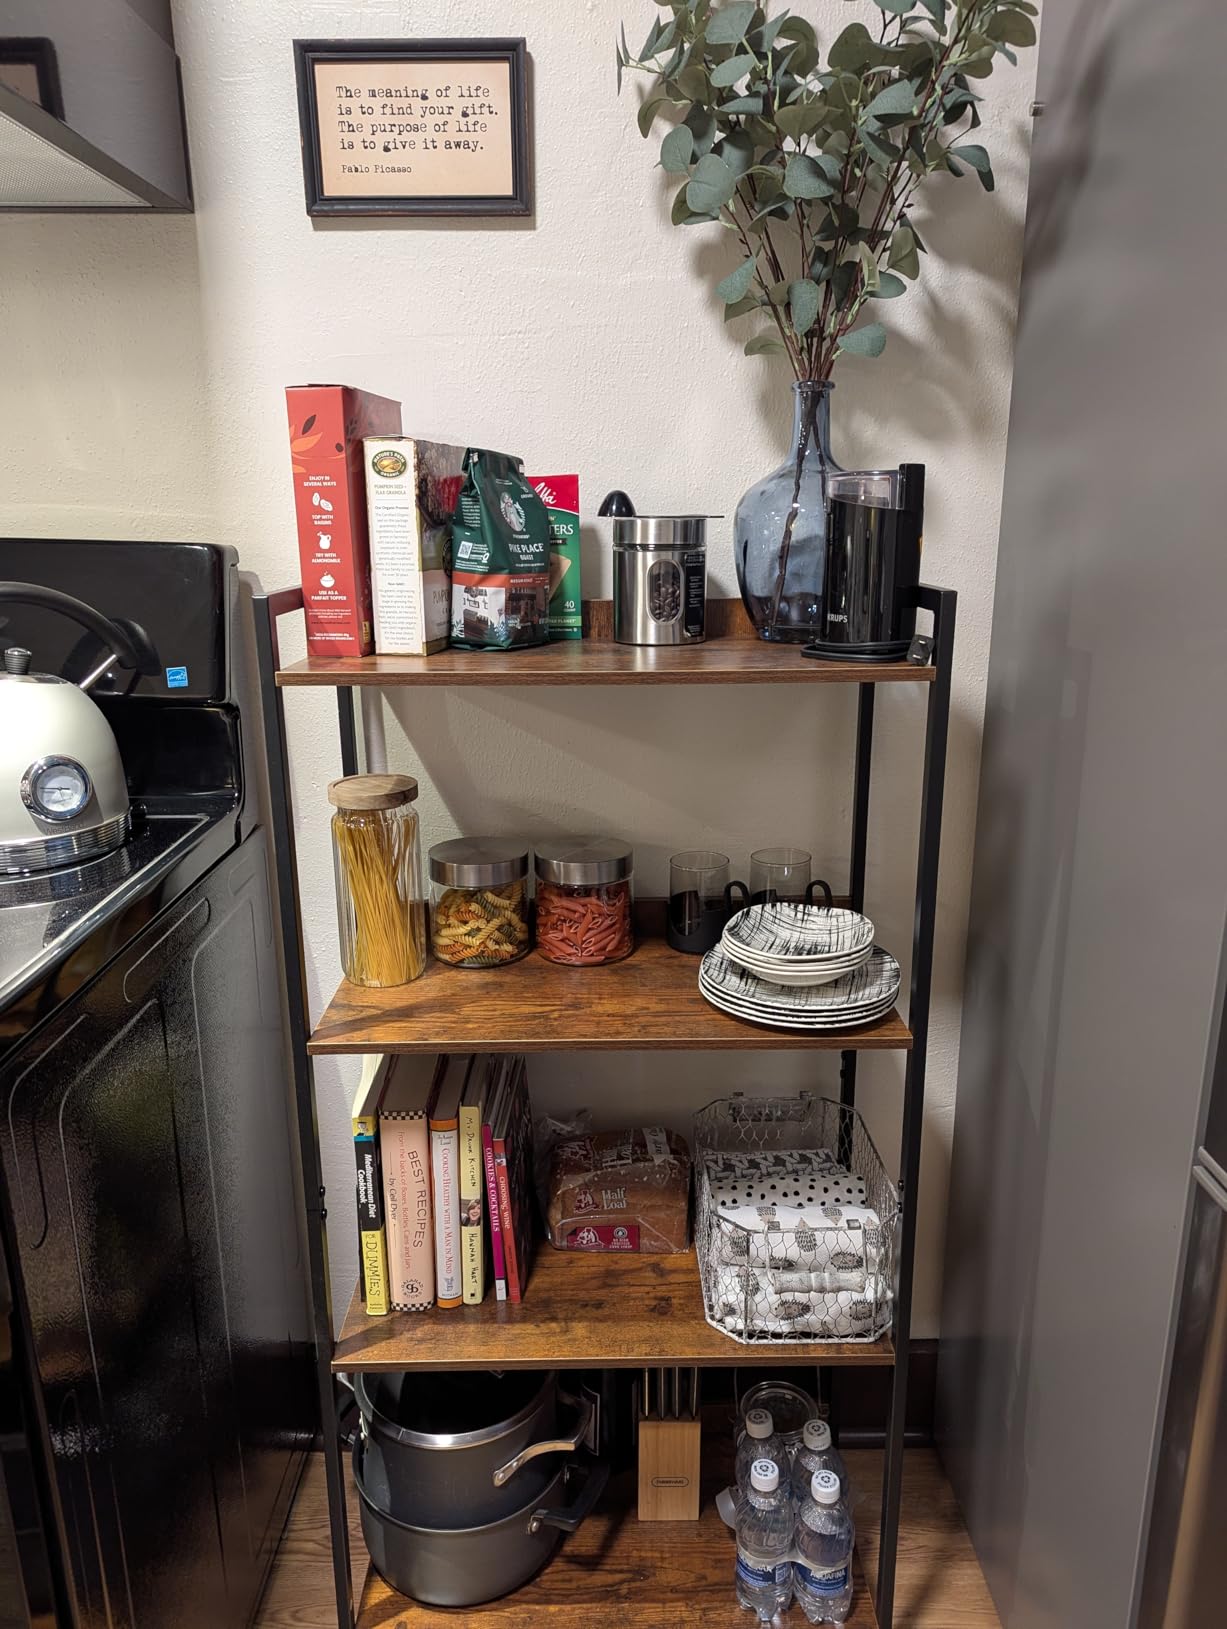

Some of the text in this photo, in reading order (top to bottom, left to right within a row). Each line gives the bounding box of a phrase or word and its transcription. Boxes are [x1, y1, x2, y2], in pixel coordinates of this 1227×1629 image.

[336, 86, 490, 101] The meaning of life
[337, 103, 498, 118] is to find your gift.
[338, 120, 488, 136] The purpose of life
[340, 138, 484, 152] is to give it away.
[342, 164, 412, 174] Pablo Picasso
[549, 524, 574, 535] TERS
[508, 543, 544, 552] PIKE PLACE
[827, 614, 848, 623] KRUPS
[486, 1148, 495, 1182] COOKIES
[364, 1154, 374, 1203] Mediterranean
[358, 1170, 367, 1203] Cookbook
[443, 1178, 451, 1206] HEALTHY
[602, 1188, 626, 1200] Half
[408, 1150, 426, 1248] BEST RECIPES
[604, 1198, 627, 1210] Loaf
[490, 1190, 499, 1232] COCKTAILS
[468, 1233, 479, 1284] HANNAH HART
[366, 1242, 380, 1296] DUMMIES
